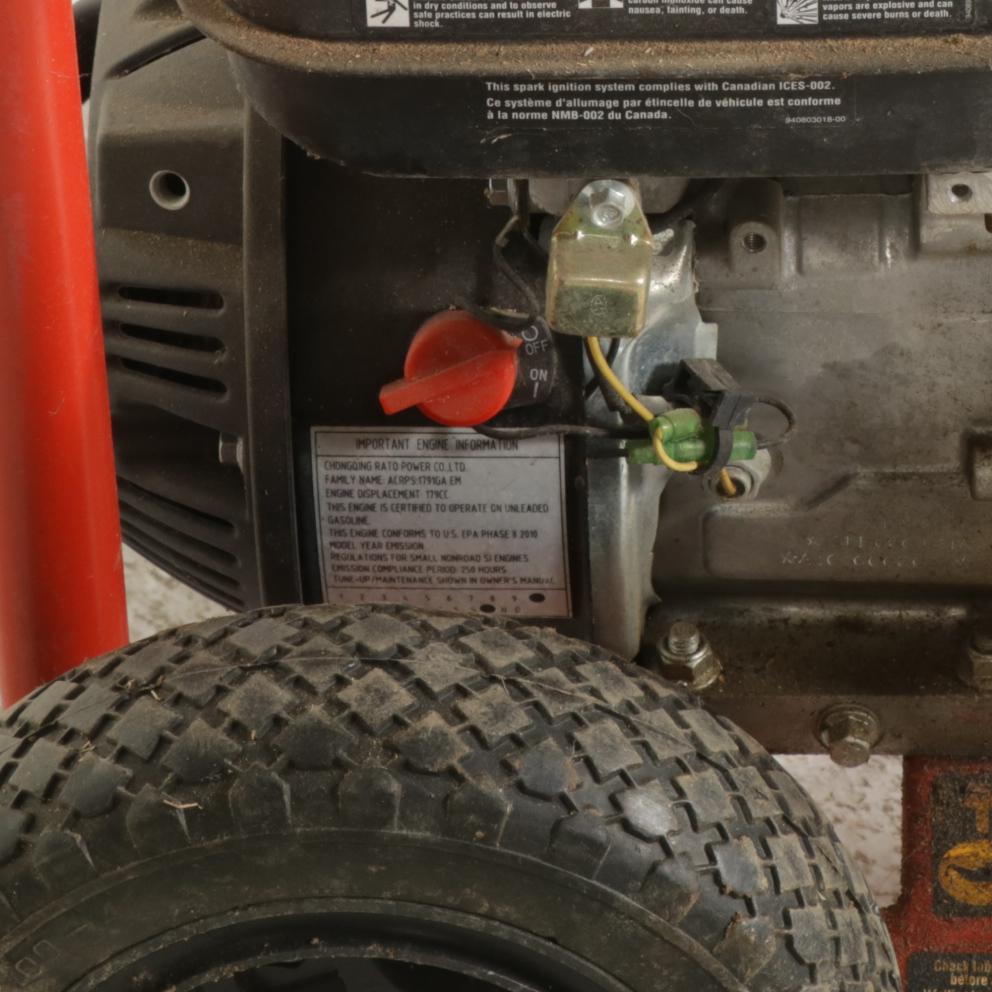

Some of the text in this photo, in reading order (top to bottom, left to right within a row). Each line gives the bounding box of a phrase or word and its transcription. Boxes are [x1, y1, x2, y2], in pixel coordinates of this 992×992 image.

[822, 3, 853, 12] vapors
[872, 0, 916, 11] explosive
[918, 0, 935, 8] and
[884, 10, 910, 19] burns
[485, 81, 836, 93] This spark ignition system complies with Canadian ICES-002.
[486, 96, 841, 109] Ce système d'allumage par étincelle de véhicule est conforme
[487, 109, 672, 120] à la norme NMB-002 du Canada.
[525, 339, 549, 355] OFF
[530, 369, 548, 382] ON
[355, 440, 518, 451] IMPORTANT ENGINE INFORMATION
